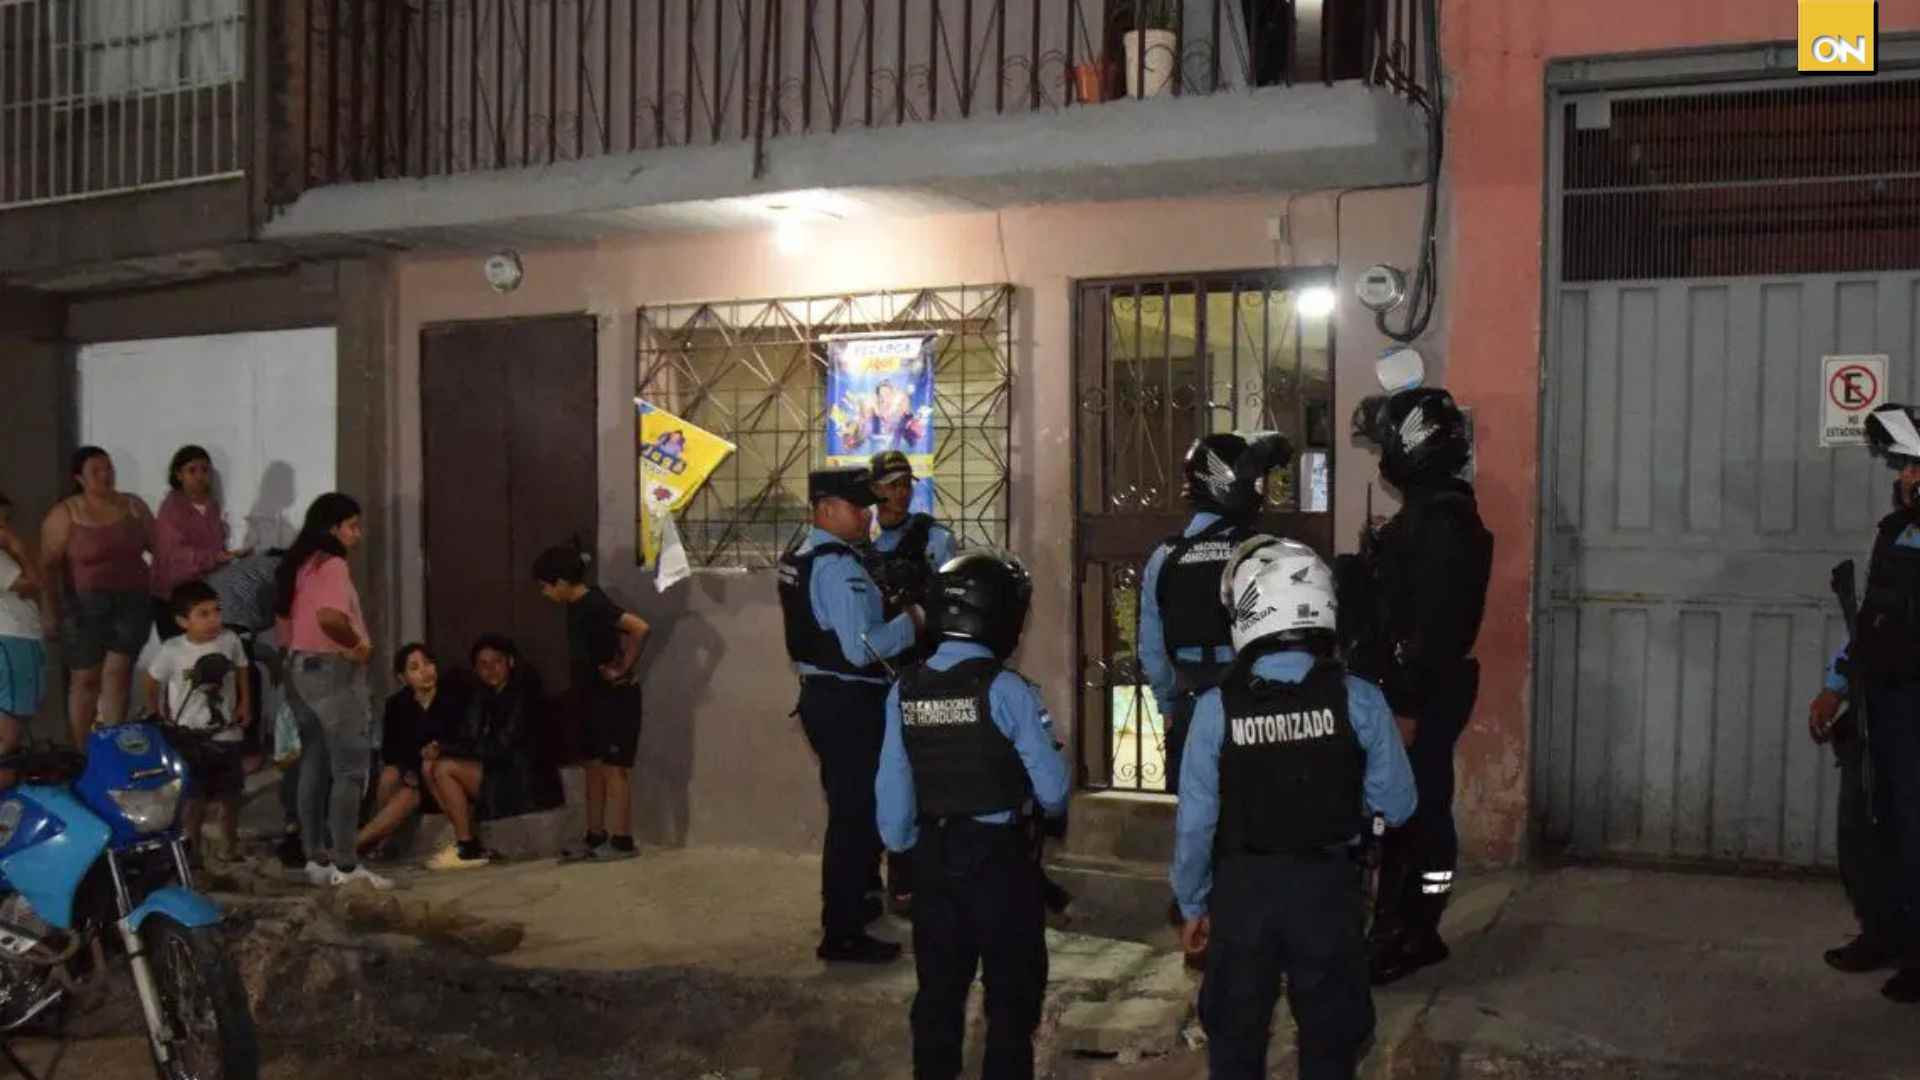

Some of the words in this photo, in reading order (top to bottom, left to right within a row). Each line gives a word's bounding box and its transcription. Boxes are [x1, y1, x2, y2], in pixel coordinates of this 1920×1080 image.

[1844, 372, 1863, 403] E
[1847, 414, 1859, 425] NO
[1240, 605, 1278, 633] HONDA
[903, 711, 918, 726] DE
[918, 709, 978, 726] HONDURAS
[1231, 707, 1335, 746] MOTORIZADO
